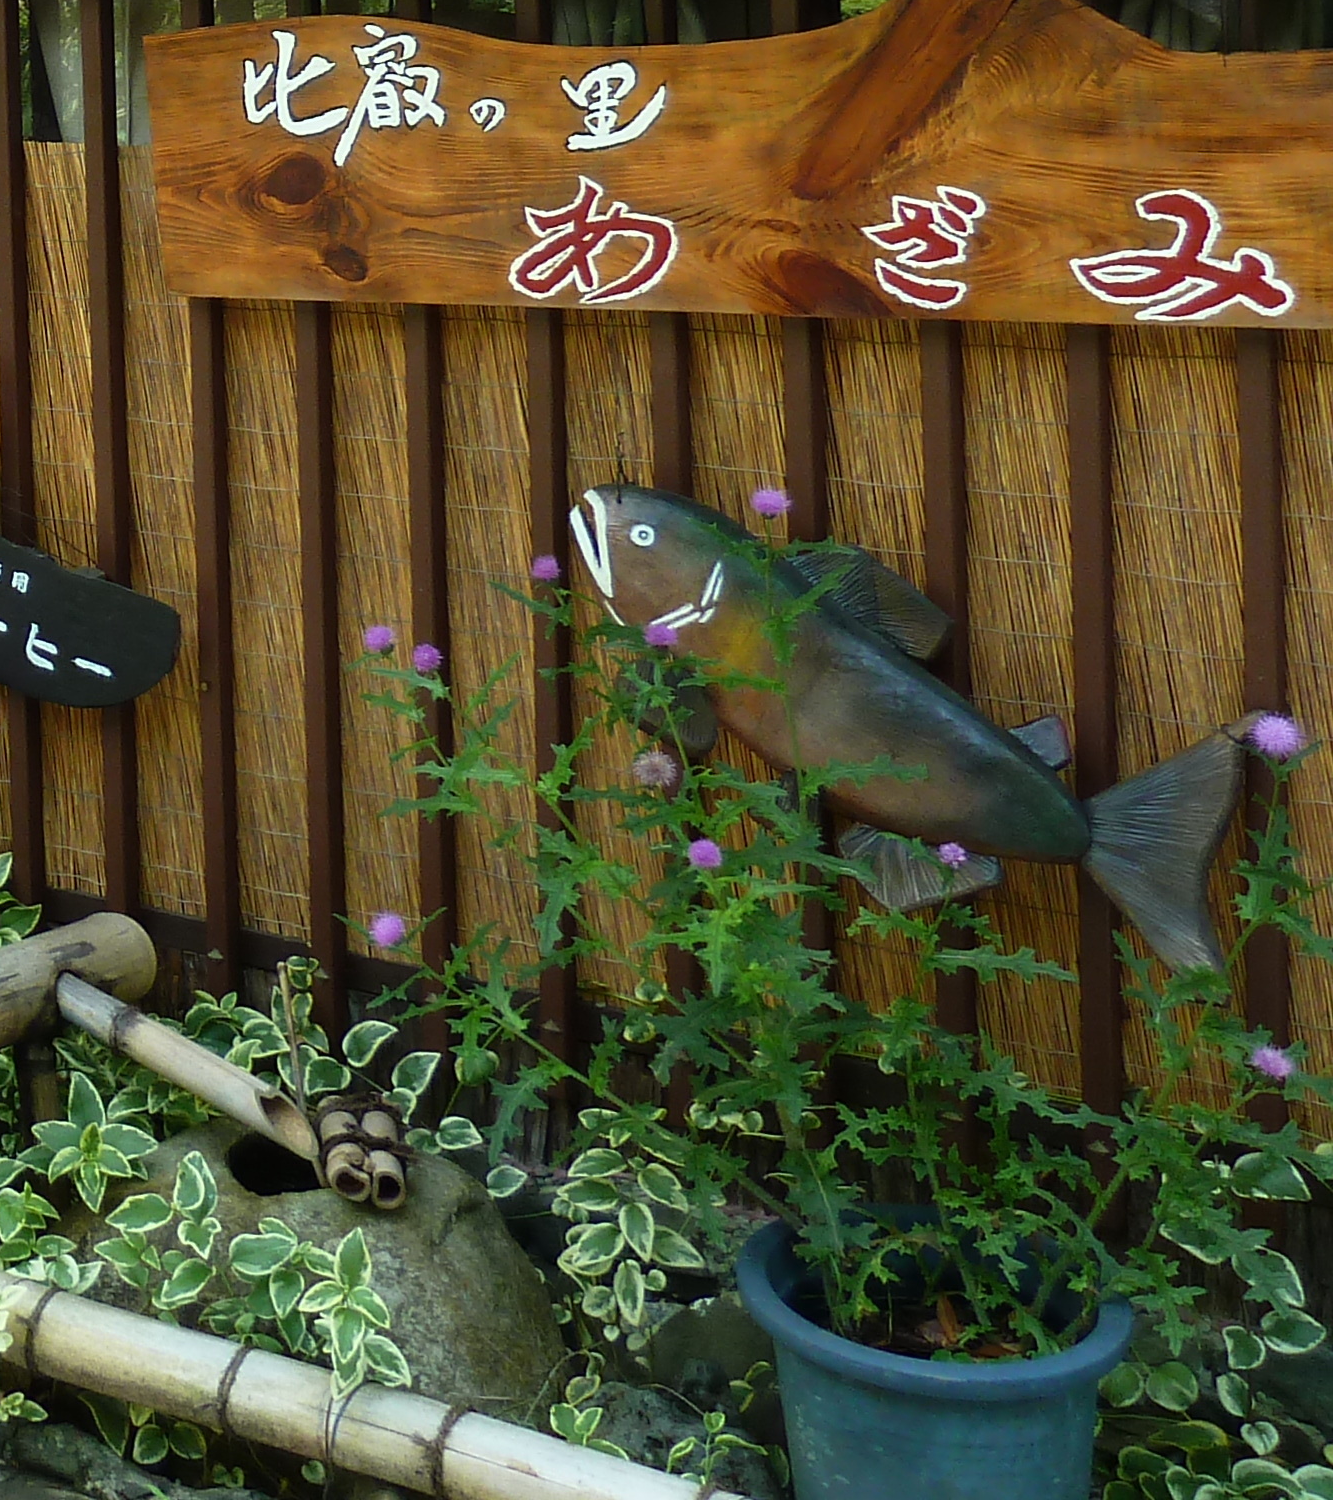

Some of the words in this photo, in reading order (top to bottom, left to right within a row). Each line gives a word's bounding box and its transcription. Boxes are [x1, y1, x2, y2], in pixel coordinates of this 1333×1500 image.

[240, 24, 667, 167] 比叡の里
[507, 175, 1296, 323] あざみ
